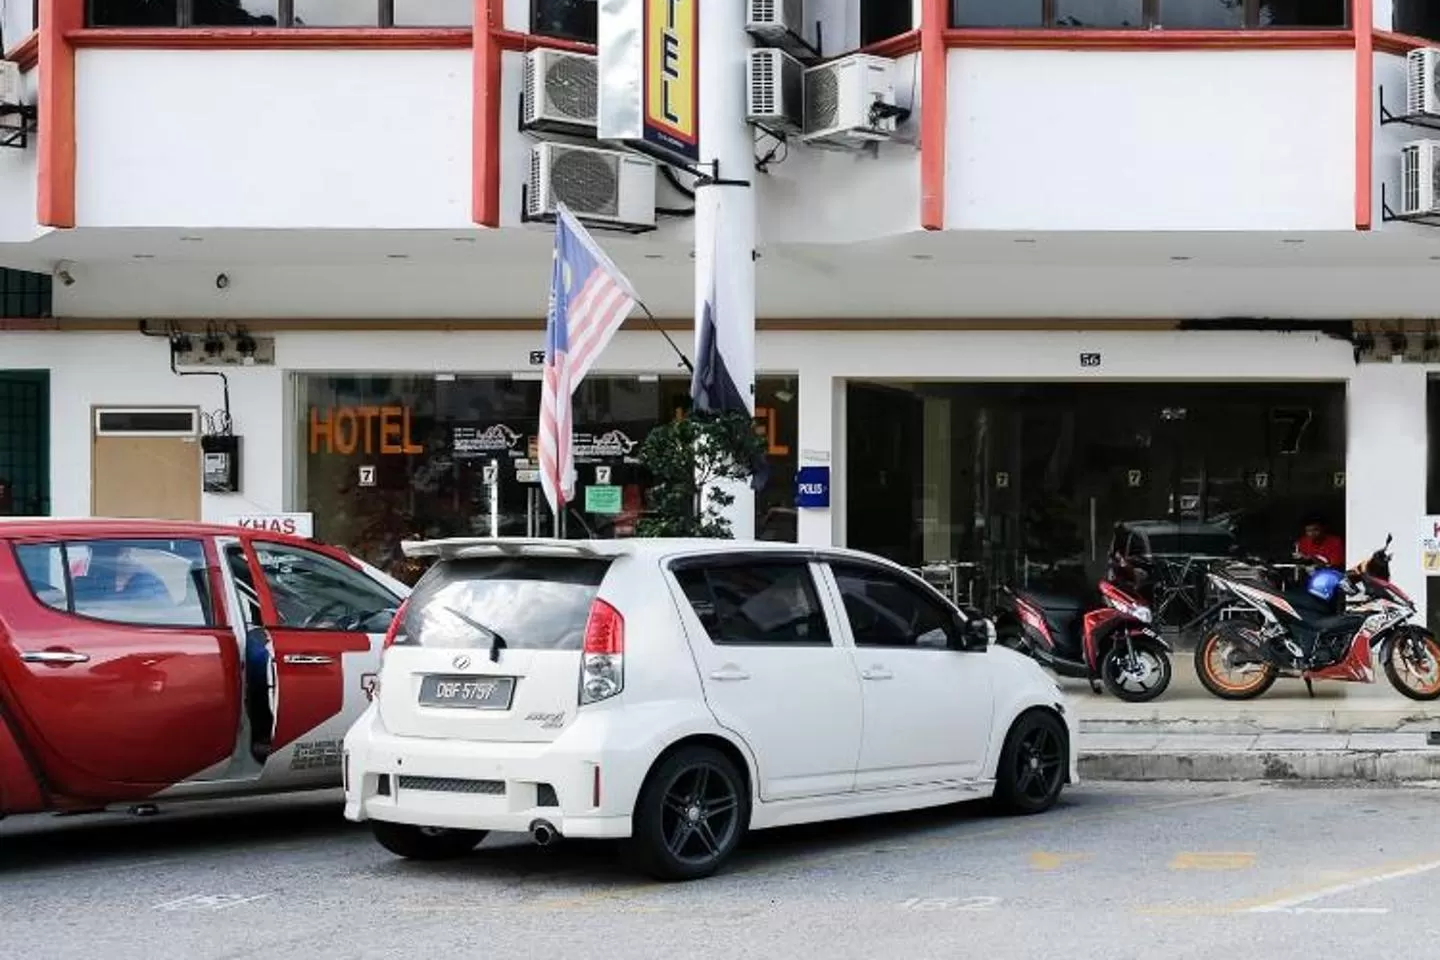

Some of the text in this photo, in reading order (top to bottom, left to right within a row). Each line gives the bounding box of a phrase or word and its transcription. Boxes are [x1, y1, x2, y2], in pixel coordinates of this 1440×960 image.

[310, 406, 424, 455] HOTEL
[799, 483, 823, 494] POLIS
[238, 518, 296, 534] KHAS
